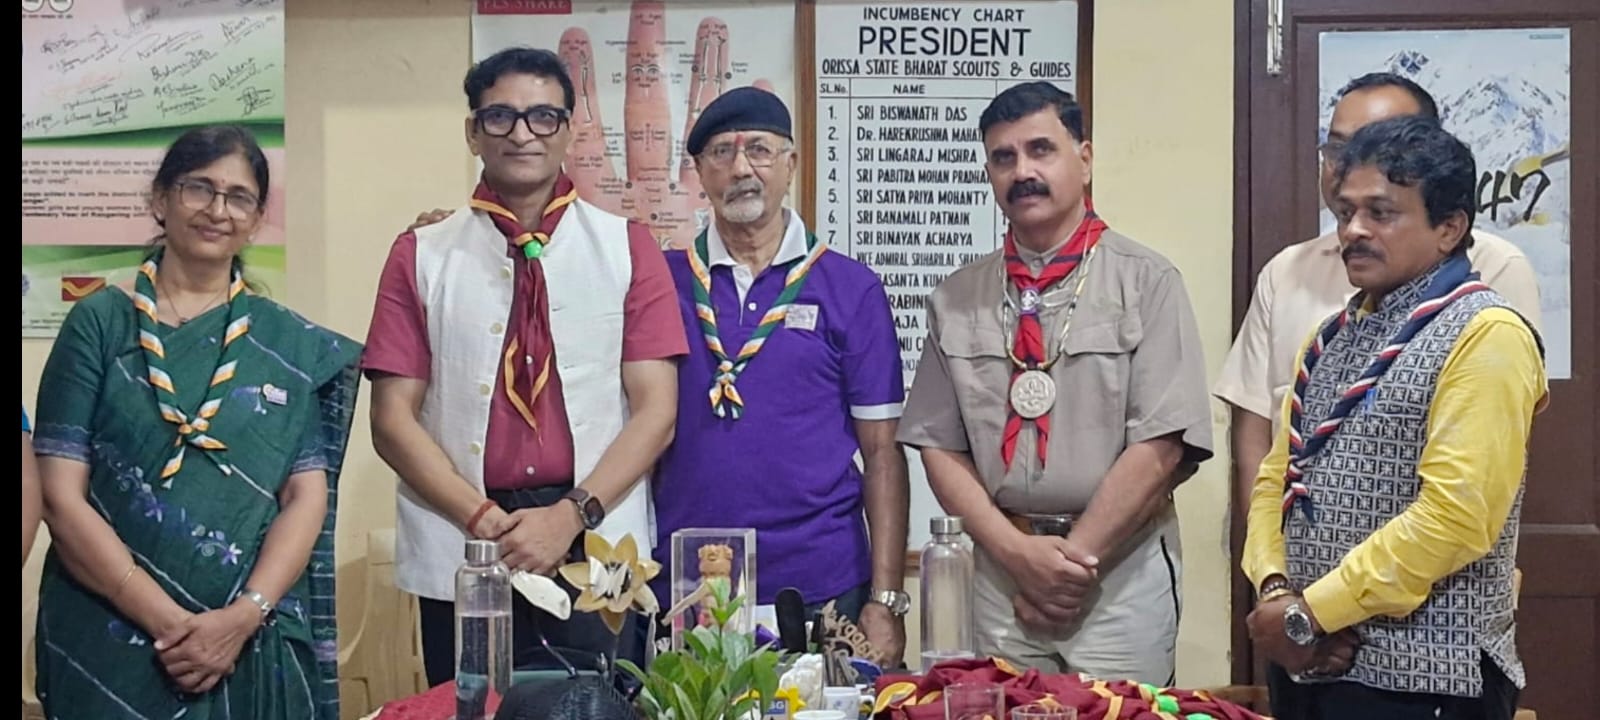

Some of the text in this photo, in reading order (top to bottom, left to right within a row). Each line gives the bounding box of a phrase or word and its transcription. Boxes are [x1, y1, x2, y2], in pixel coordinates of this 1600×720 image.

[863, 7, 1025, 23] INCUMBENCY CHART
[858, 26, 1032, 57] PRESIDENT
[821, 58, 1072, 78] ORISSA STATE BHARAT SCOUTS & GUIDES
[892, 84, 925, 95] NAME
[827, 105, 968, 122] 1. SRI BISWANATH DAS
[827, 126, 839, 141] 2.
[879, 126, 949, 142] HAREKRUSHNA
[827, 147, 977, 164] 3. SRI LINGARAJ MISHRA
[827, 169, 840, 183] 4.
[856, 169, 873, 183] SRI
[877, 169, 915, 184] PABITRA
[917, 169, 949, 184] MOHAN
[827, 189, 989, 206] 5. SRI SATYA PRIYA MOHANTY
[827, 210, 971, 226] 6. SRI BANAMALI PATNAIK
[827, 231, 973, 247] 7. SRI BINAYAK ACHARYA
[875, 252, 909, 266] ADMIRAL
